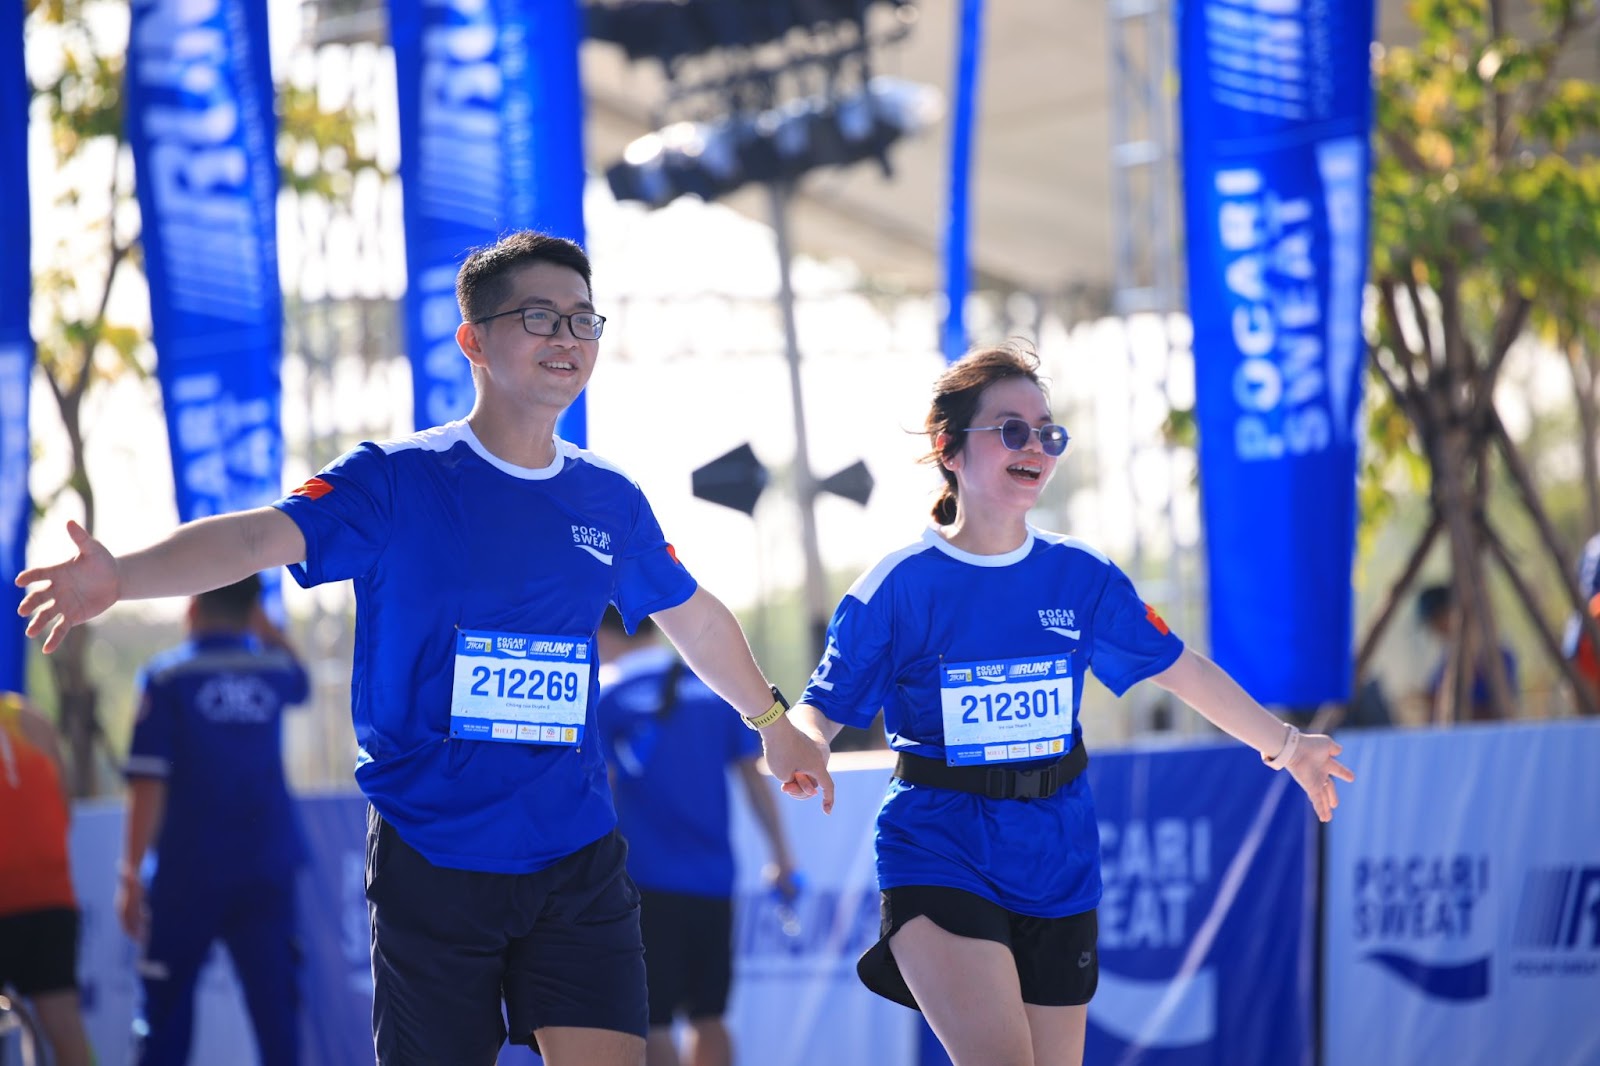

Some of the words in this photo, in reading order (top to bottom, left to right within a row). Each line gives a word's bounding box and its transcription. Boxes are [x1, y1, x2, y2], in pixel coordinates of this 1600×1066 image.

[1214, 167, 1287, 461] POCARI
[1264, 192, 1330, 456] SWEAT
[497, 637, 527, 645] POCARI
[497, 642, 524, 650] SWEAT
[470, 665, 578, 703] 212269
[976, 664, 1005, 672] POCARI
[961, 687, 1060, 725] 212301
[1353, 854, 1491, 899] POCARI
[1353, 899, 1474, 942] SWEAT
